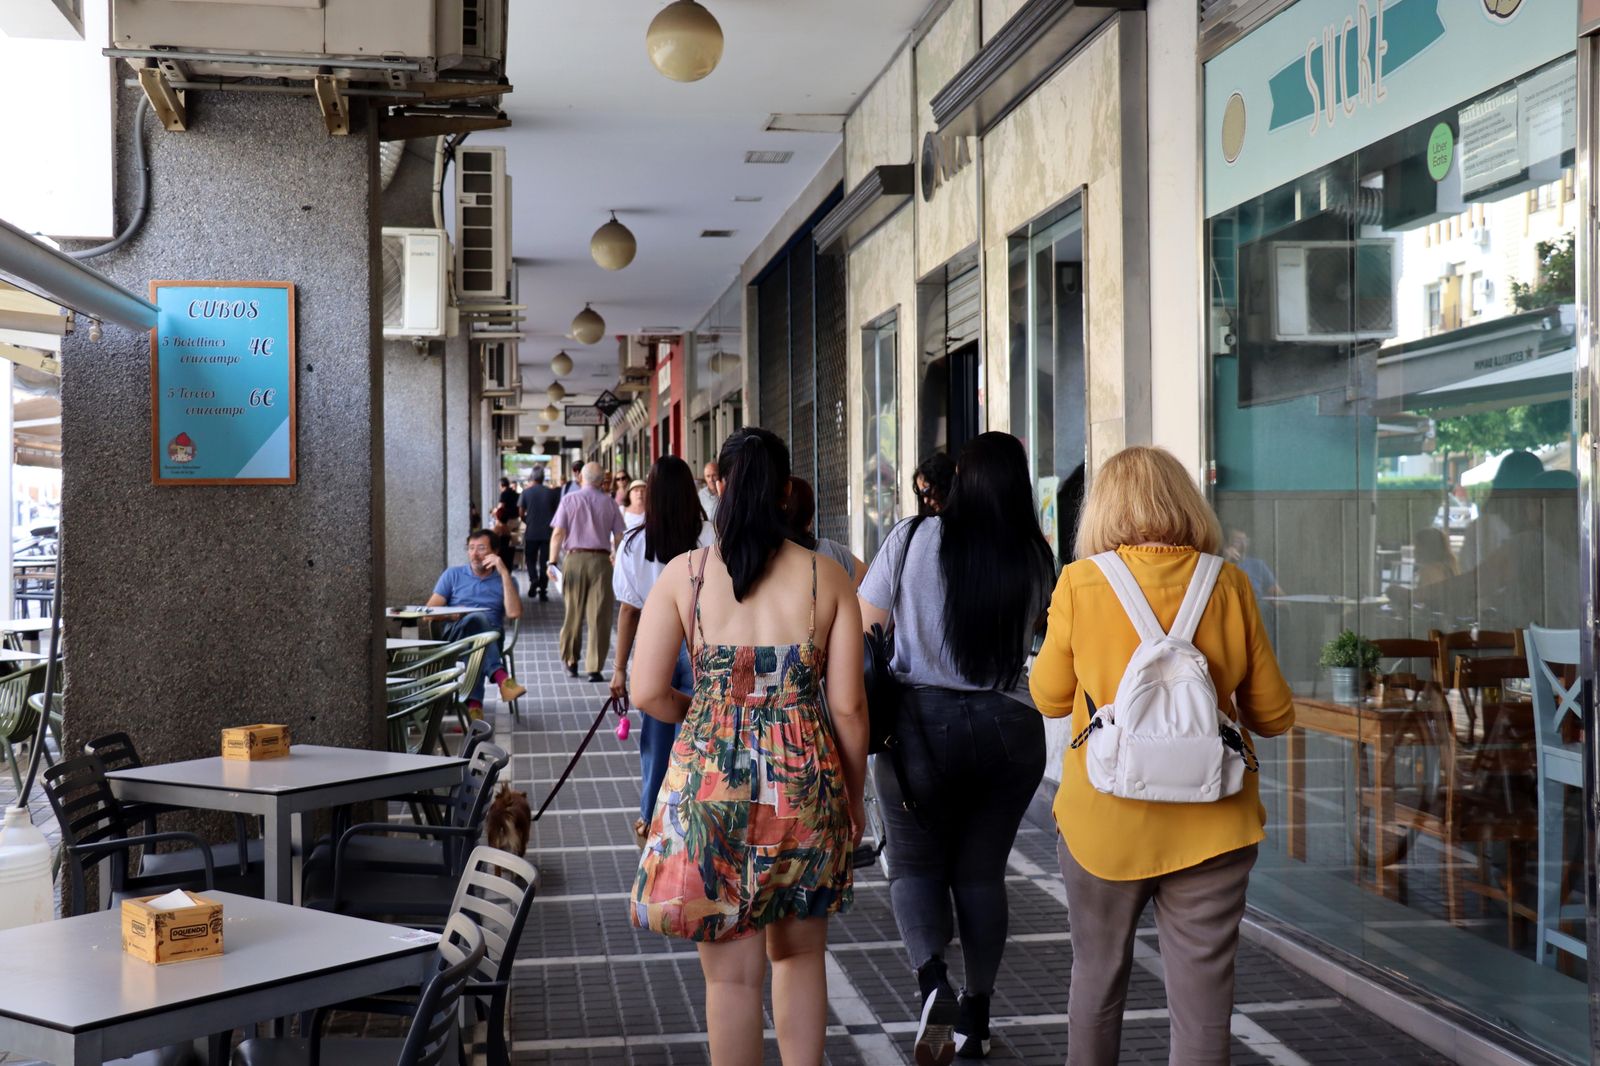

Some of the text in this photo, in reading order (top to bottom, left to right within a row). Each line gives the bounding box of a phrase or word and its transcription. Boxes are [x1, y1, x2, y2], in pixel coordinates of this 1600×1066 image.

[1304, 0, 1389, 135] SUCRE
[1432, 141, 1448, 155] Uber
[1432, 154, 1448, 168] Eats
[188, 299, 260, 320] CUBOS
[161, 337, 169, 347] 5
[248, 337, 275, 357] 4€
[180, 355, 241, 366] cruzcampo
[167, 387, 276, 408] 5 Tercios 6€
[185, 406, 245, 417] cruzcampo
[172, 926, 206, 937] OQUENDO
